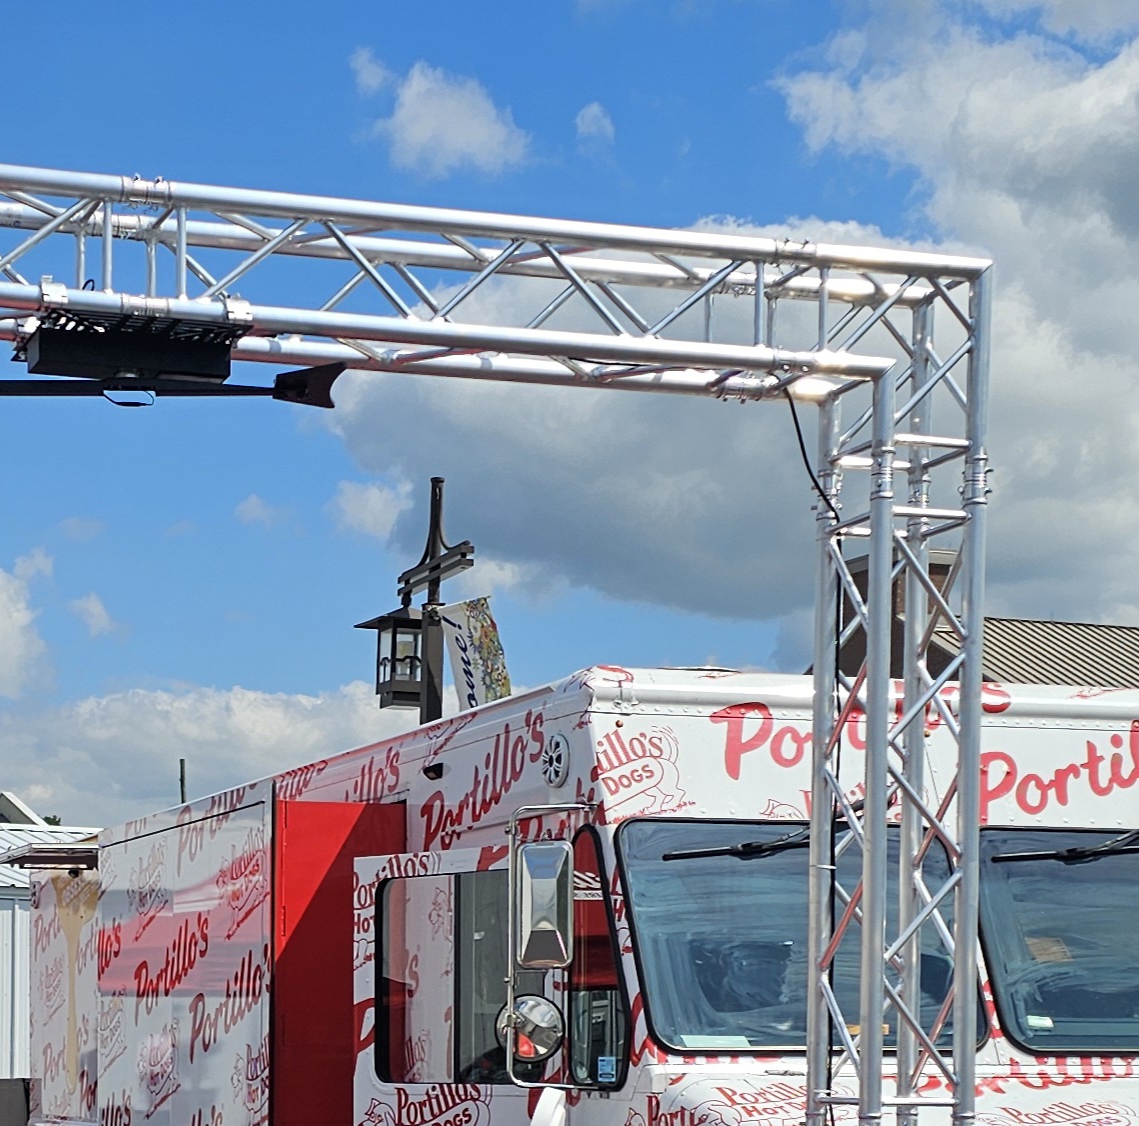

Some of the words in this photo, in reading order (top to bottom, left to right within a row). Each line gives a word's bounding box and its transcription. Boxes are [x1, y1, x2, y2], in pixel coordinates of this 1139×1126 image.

[420, 709, 545, 852] Portillo's
[601, 764, 655, 796] DOGS
[979, 719, 1139, 826] Portil
[134, 911, 209, 1027] Portillo's
[395, 1083, 481, 1126] Portillo's
[997, 1101, 1120, 1125] Portillo's
